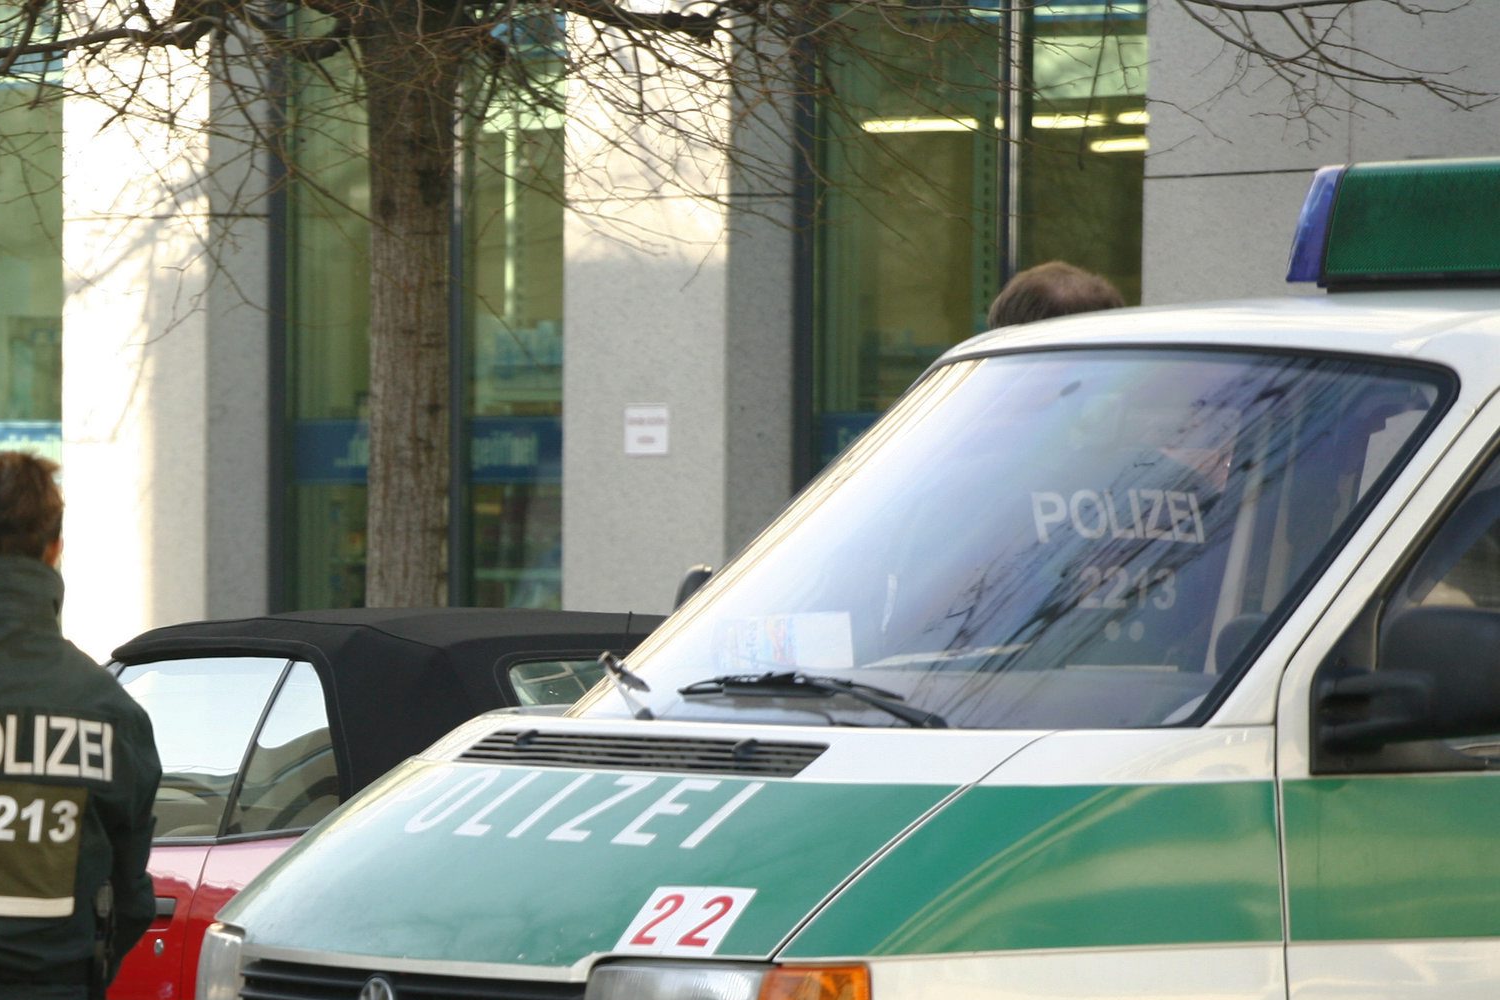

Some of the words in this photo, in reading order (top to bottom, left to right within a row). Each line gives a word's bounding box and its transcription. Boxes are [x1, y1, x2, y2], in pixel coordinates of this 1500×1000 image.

[1031, 488, 1206, 544] POLIZEI
[1076, 565, 1177, 611] 2213
[628, 893, 735, 948] 22
